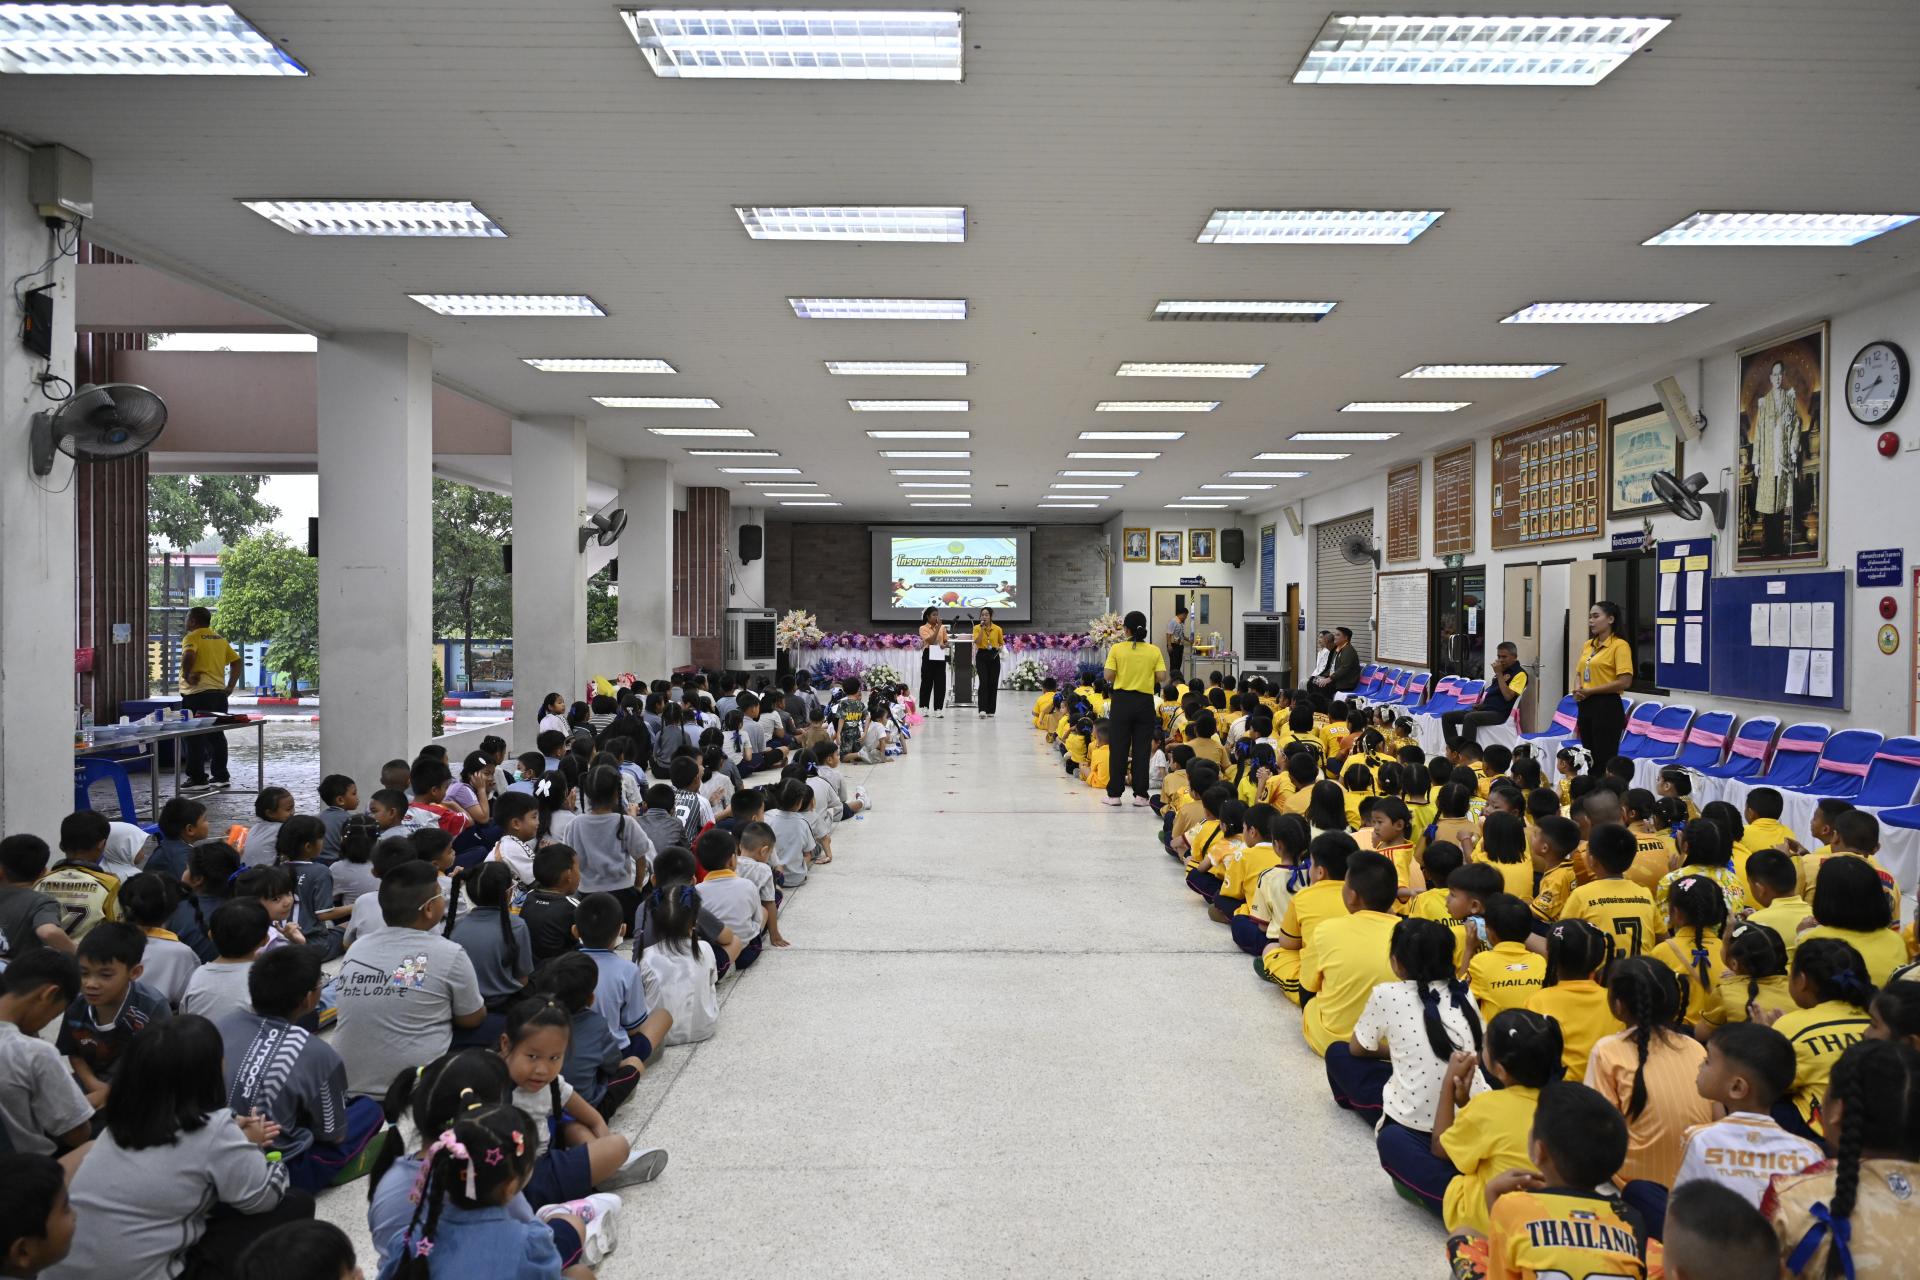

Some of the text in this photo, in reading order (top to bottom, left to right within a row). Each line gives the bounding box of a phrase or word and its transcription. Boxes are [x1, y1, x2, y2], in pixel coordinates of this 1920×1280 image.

[1873, 350, 1881, 360] 12
[1885, 352, 1889, 360] 1
[1865, 357, 1871, 365] 11
[1891, 360, 1897, 370] 2
[1857, 368, 1865, 378] 10
[1892, 375, 1899, 384] 3
[1855, 382, 1860, 393] 9
[1889, 389, 1896, 399] 4
[1857, 396, 1863, 405] 8
[1882, 400, 1889, 411] 5
[1864, 405, 1869, 414] 7
[1873, 406, 1879, 416] 6
[64, 904, 90, 935] 7
[351, 971, 392, 985] Family
[1490, 979, 1542, 989] THAILAN
[1525, 1220, 1640, 1257] THAILAND
